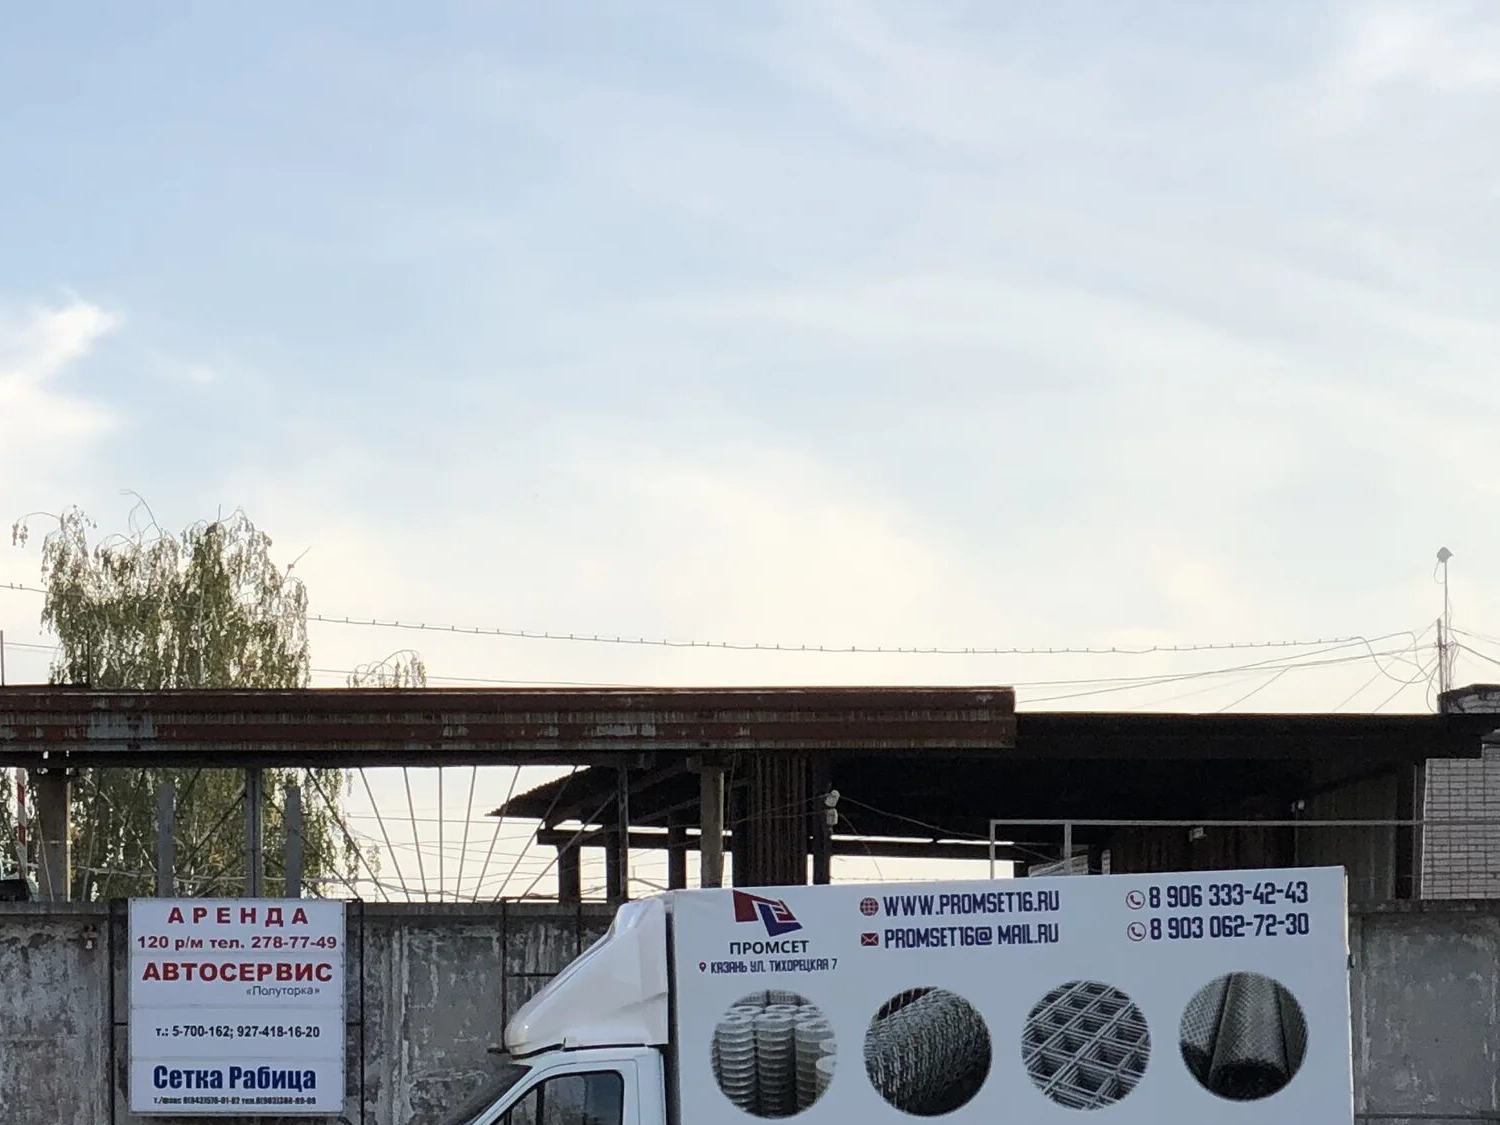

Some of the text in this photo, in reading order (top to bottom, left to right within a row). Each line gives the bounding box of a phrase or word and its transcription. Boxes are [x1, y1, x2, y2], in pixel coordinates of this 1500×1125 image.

[883, 890, 1060, 917] WWW.PROMSET16.RU
[1148, 880, 1309, 909] 8 906 333-42-43
[167, 906, 309, 928] АРЕНДА
[1150, 912, 1310, 940] 8 903 062-72-30
[137, 935, 337, 952] 120 р/м тел. 278-77-49
[729, 939, 810, 955] ПРОМСЕТ
[141, 962, 333, 982] АВТОСЕРВИС
[710, 961, 748, 974] КАЗАНЬ
[769, 958, 829, 973] ТИХОРЕЦКАЯ
[831, 958, 838, 970] 7
[171, 1025, 234, 1039] 5-700-162;
[236, 1025, 321, 1038] 927-418-16-20
[153, 1065, 317, 1093] Сетка Рабица
